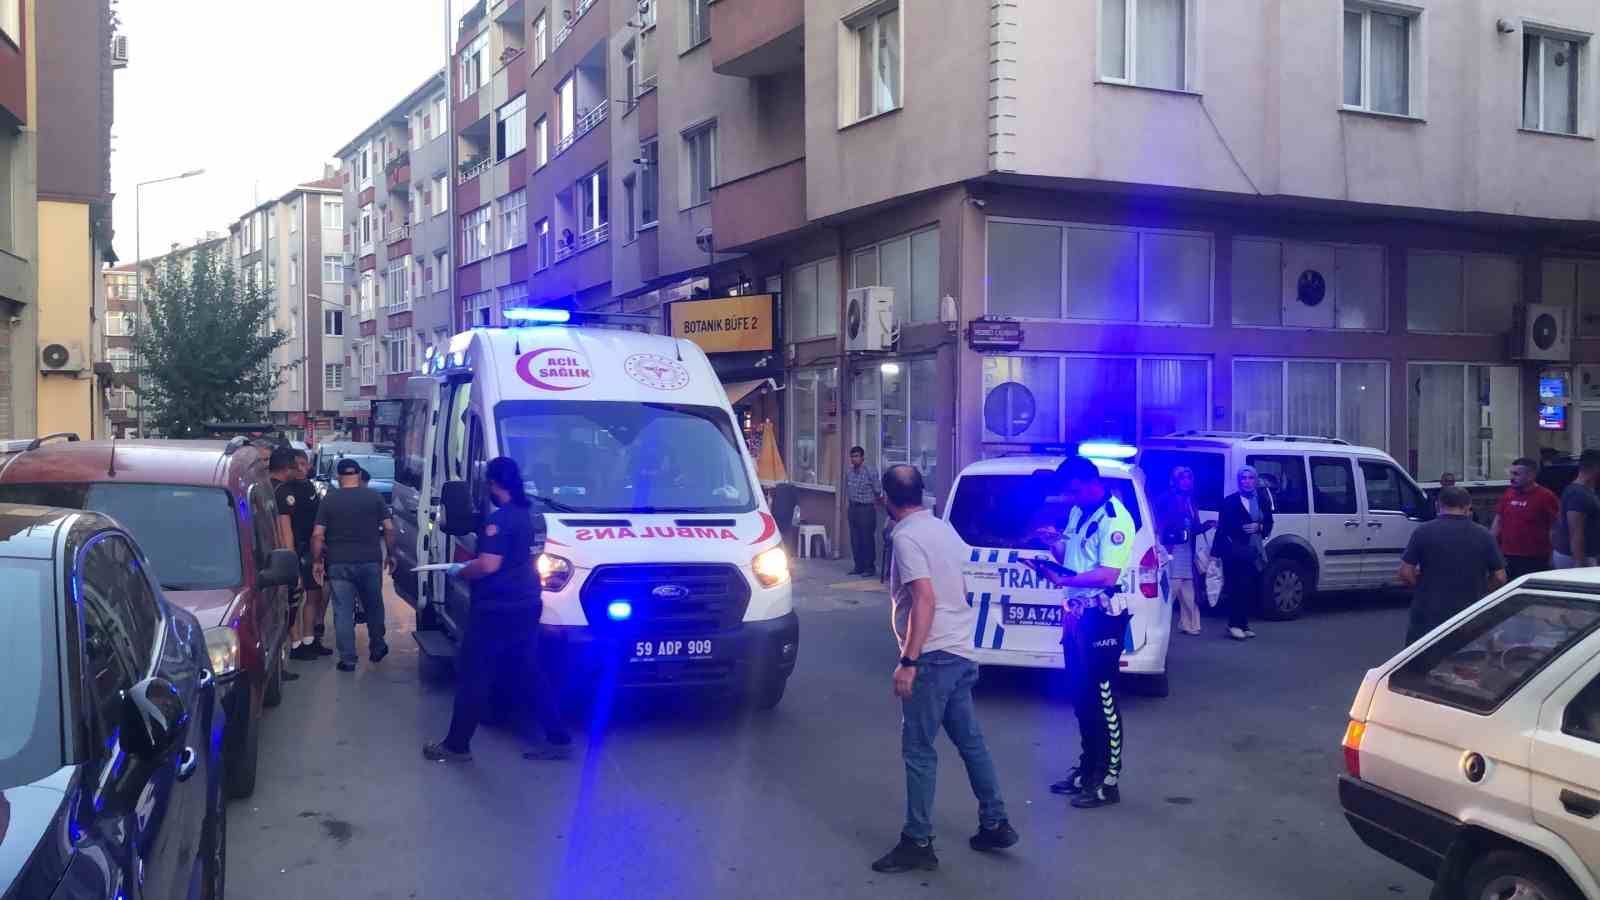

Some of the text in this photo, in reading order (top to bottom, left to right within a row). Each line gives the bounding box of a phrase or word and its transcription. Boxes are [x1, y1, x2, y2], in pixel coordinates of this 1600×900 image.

[725, 314, 749, 331] BÜFE
[751, 317, 758, 330] 2
[547, 356, 580, 366] ACİL
[539, 367, 590, 378] SAĞLIK
[998, 568, 1063, 589] TRAF
[1009, 606, 1024, 619] 59
[1027, 607, 1036, 620] A
[636, 639, 712, 656] 59 ADP 909
